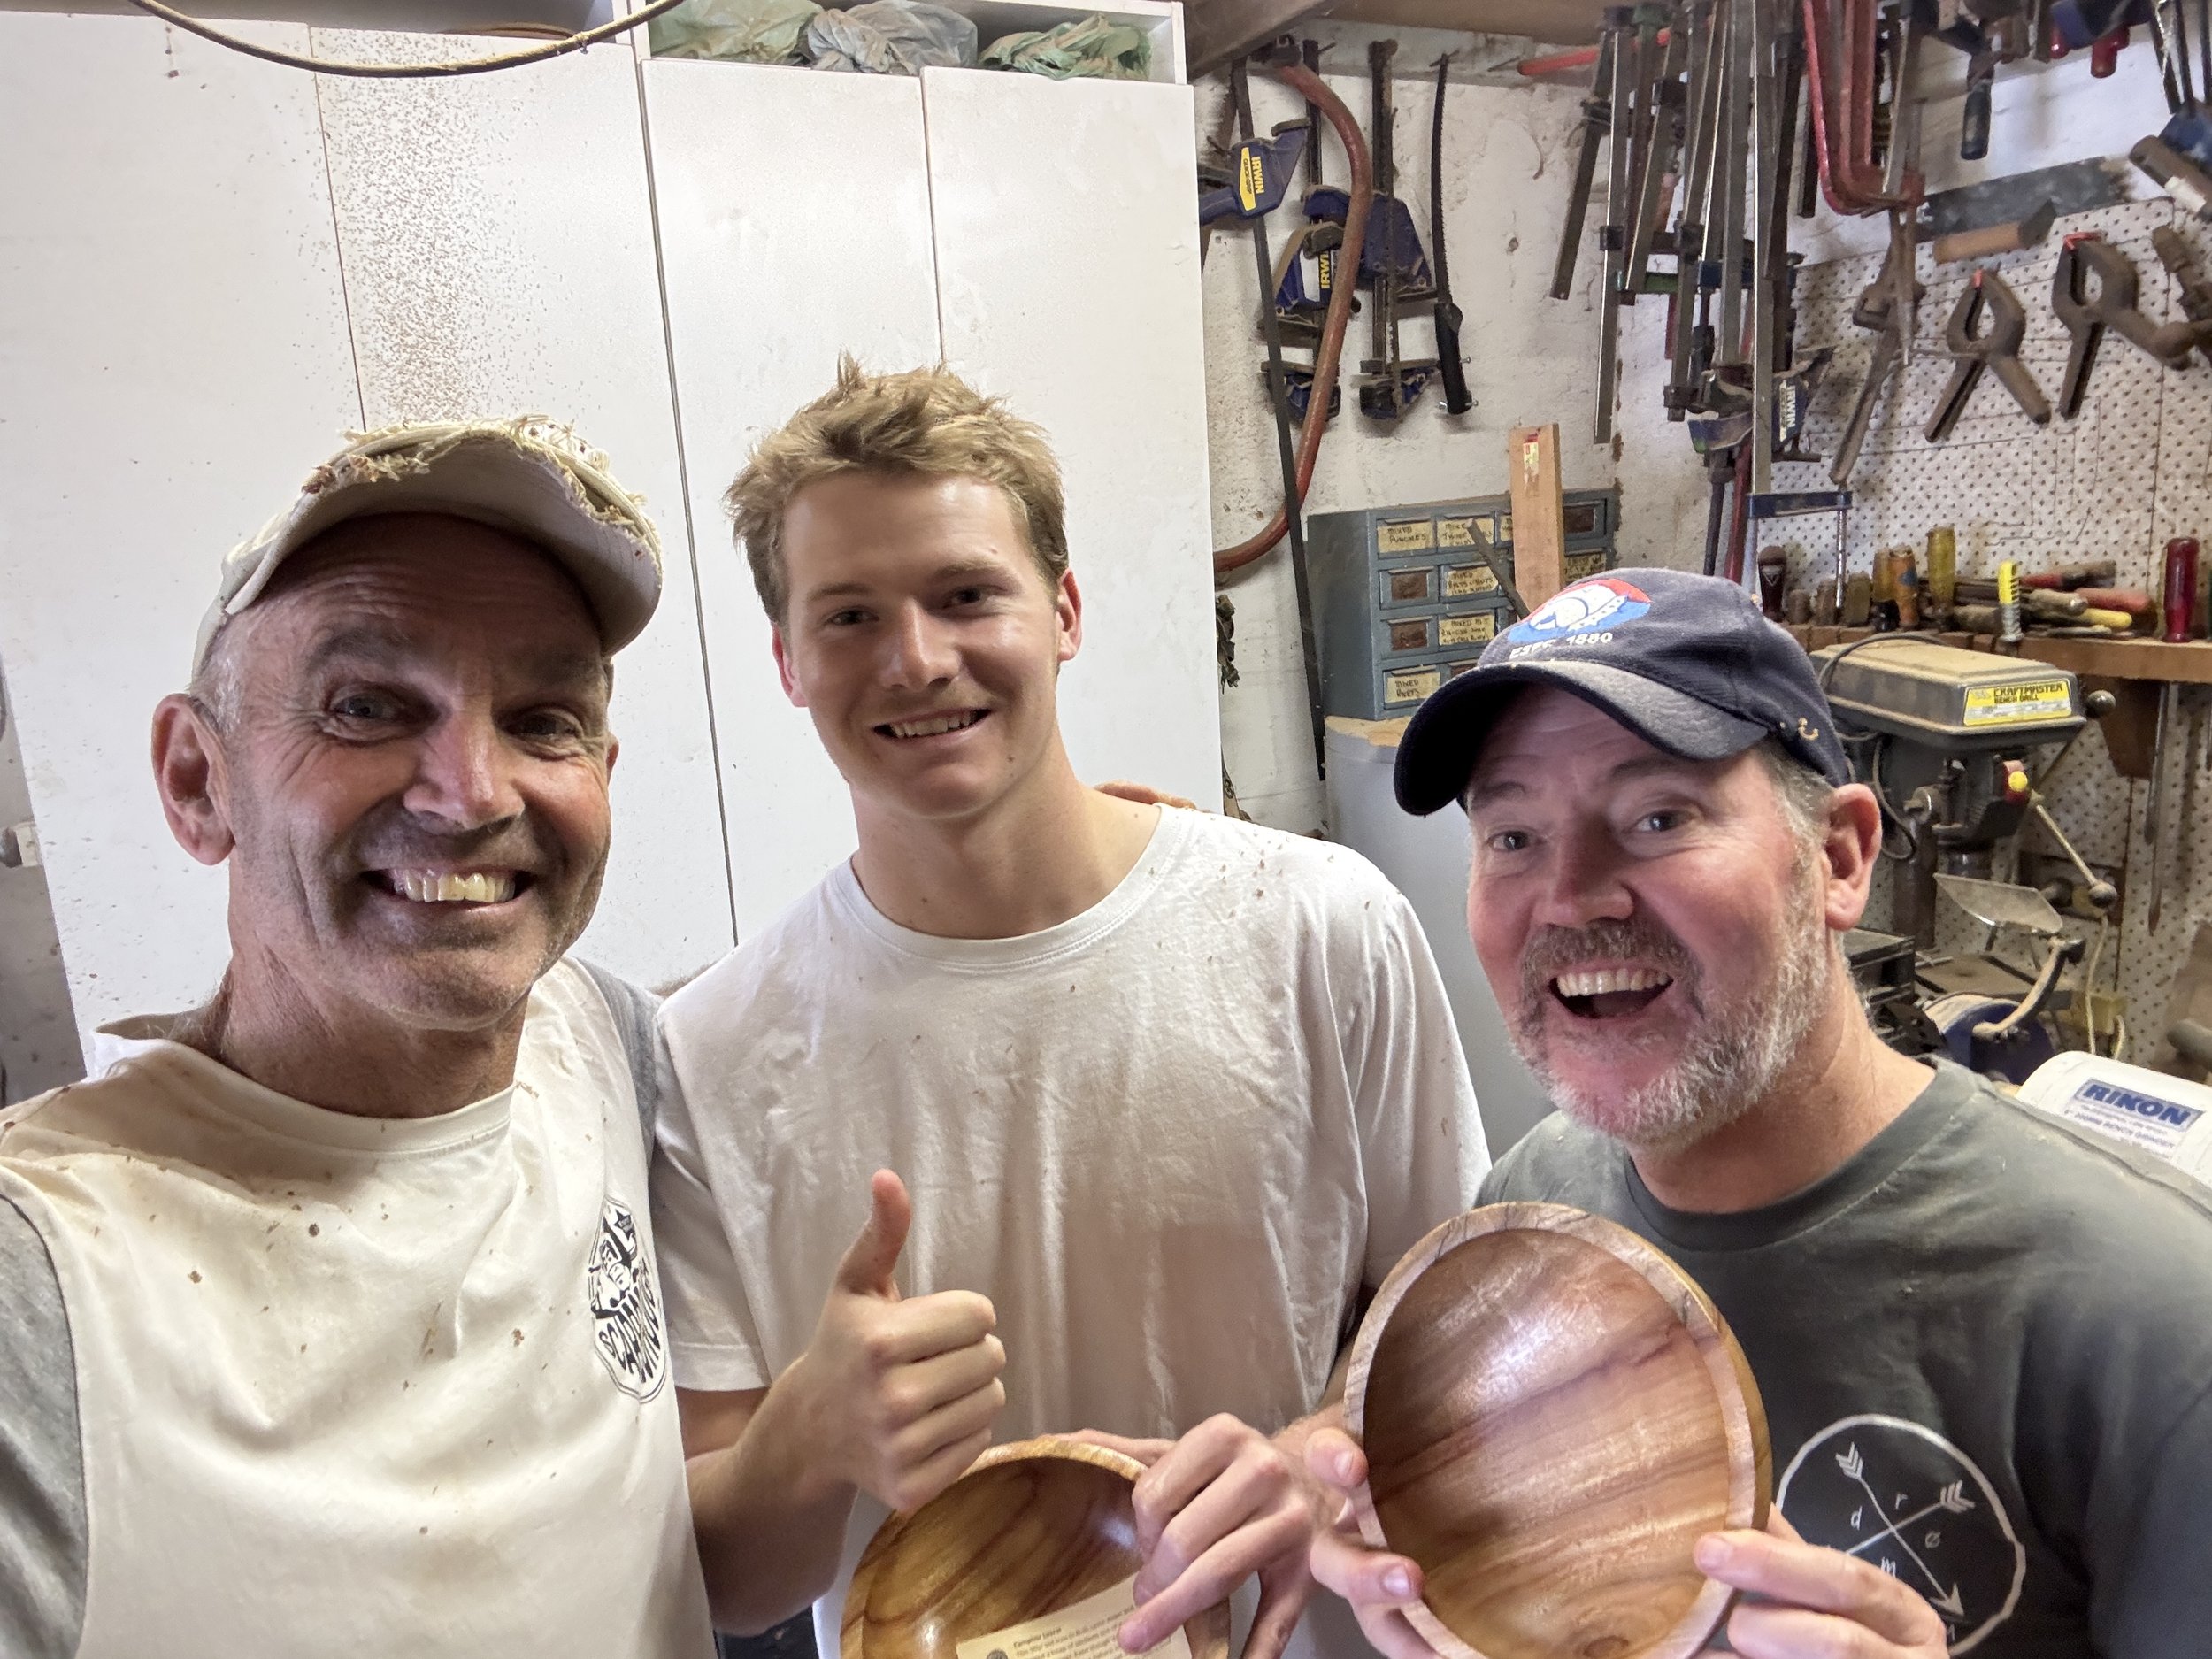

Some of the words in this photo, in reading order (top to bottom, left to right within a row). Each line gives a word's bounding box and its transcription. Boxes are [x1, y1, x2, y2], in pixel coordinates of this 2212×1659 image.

[1251, 156, 1265, 194] IRWIN
[1319, 251, 1330, 289] IRWI
[1786, 385, 1796, 427] IRWIN
[1389, 533, 1426, 543] PUNCHES
[1993, 683, 2063, 697] CRAFTMASTER
[2083, 1084, 2191, 1125] RIKON
